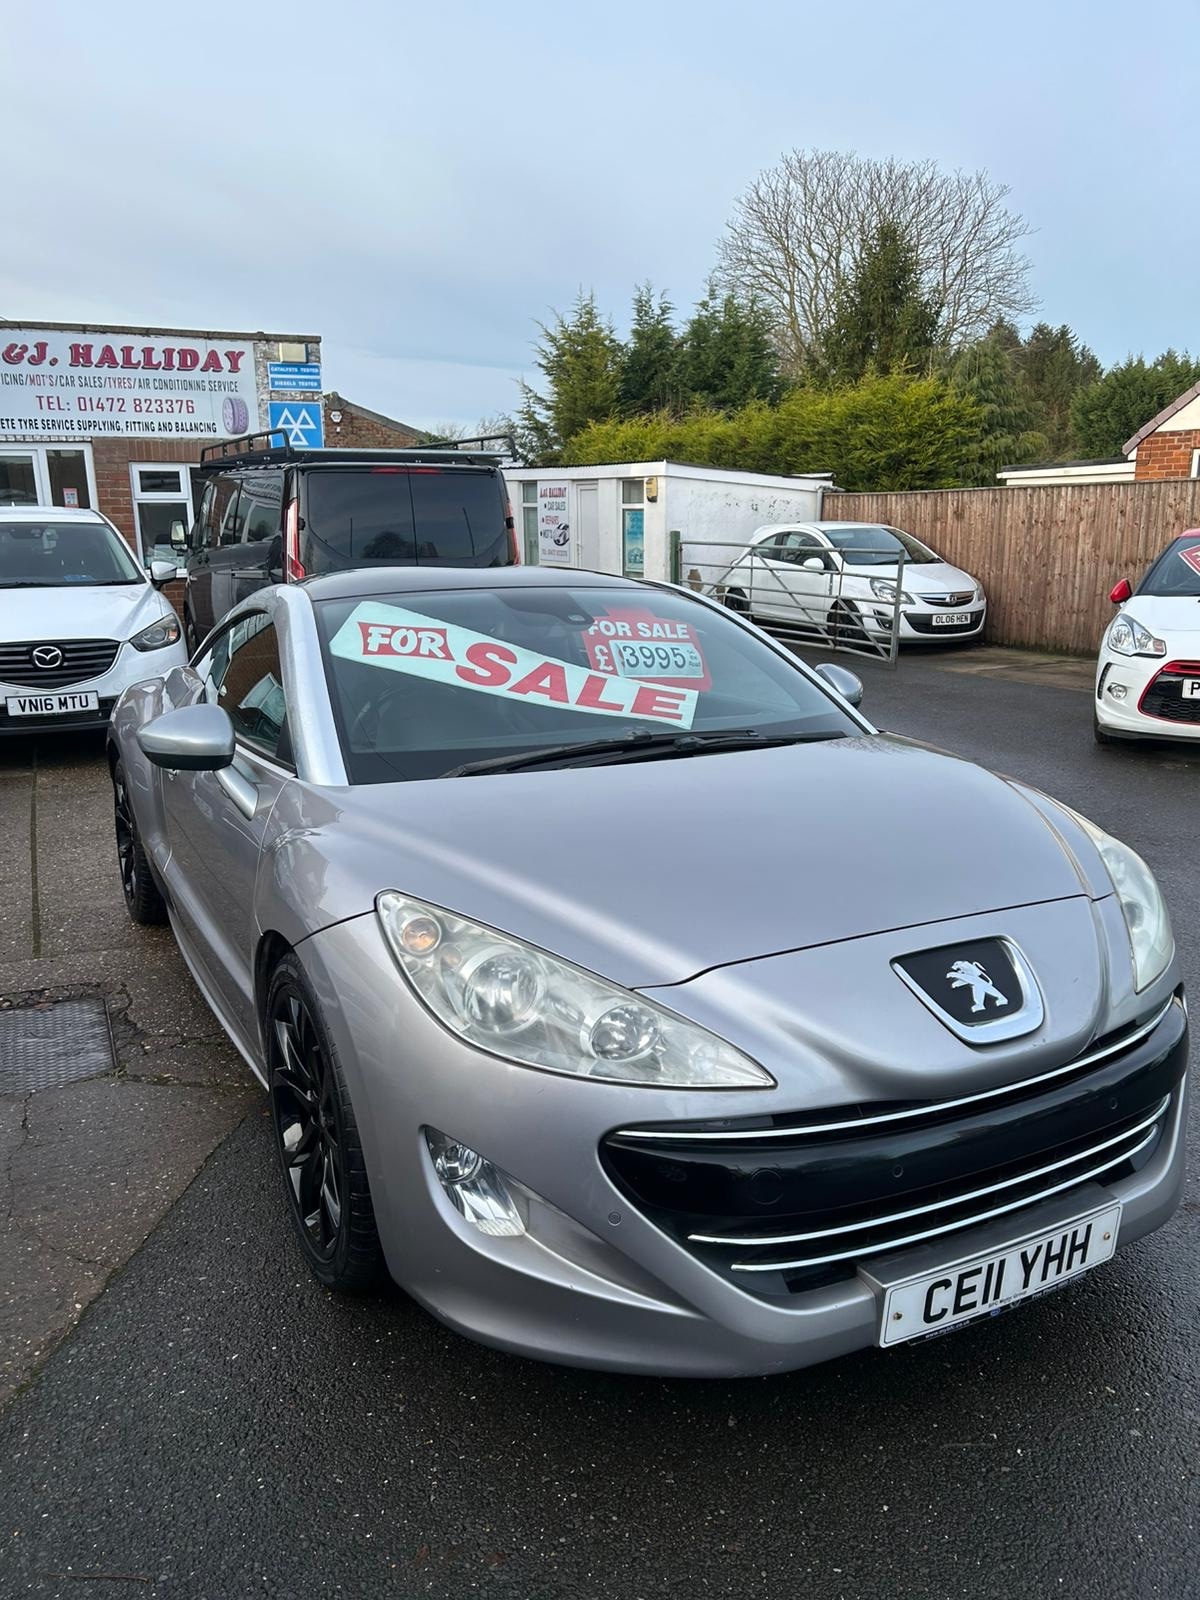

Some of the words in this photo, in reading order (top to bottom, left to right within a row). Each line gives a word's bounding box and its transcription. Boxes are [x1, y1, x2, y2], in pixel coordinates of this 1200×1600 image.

[69, 343, 245, 373] HALLIDAY
[153, 378, 206, 392] CONDITIONING
[209, 380, 239, 393] SERVICE
[36, 395, 71, 411] TEL:
[77, 396, 127, 412] 01472
[133, 398, 195, 414] 823376
[18, 418, 40, 430] TYRE
[42, 419, 75, 431] SERVICE
[77, 420, 124, 434] SUPPLYING,
[125, 421, 155, 432] FITTING
[158, 422, 173, 432] AND
[175, 422, 217, 433] BALANCING
[588, 620, 632, 636] FOR
[637, 622, 690, 639] SALE
[594, 645, 613, 671] £
[622, 645, 686, 669] 3995
[367, 626, 446, 659] FOR
[456, 642, 687, 721] SALE
[1190, 681, 1200, 695] P
[18, 698, 54, 712] VN16
[58, 695, 89, 710] MTU
[922, 1258, 1006, 1324] CE11
[1020, 1223, 1093, 1289] YHH
